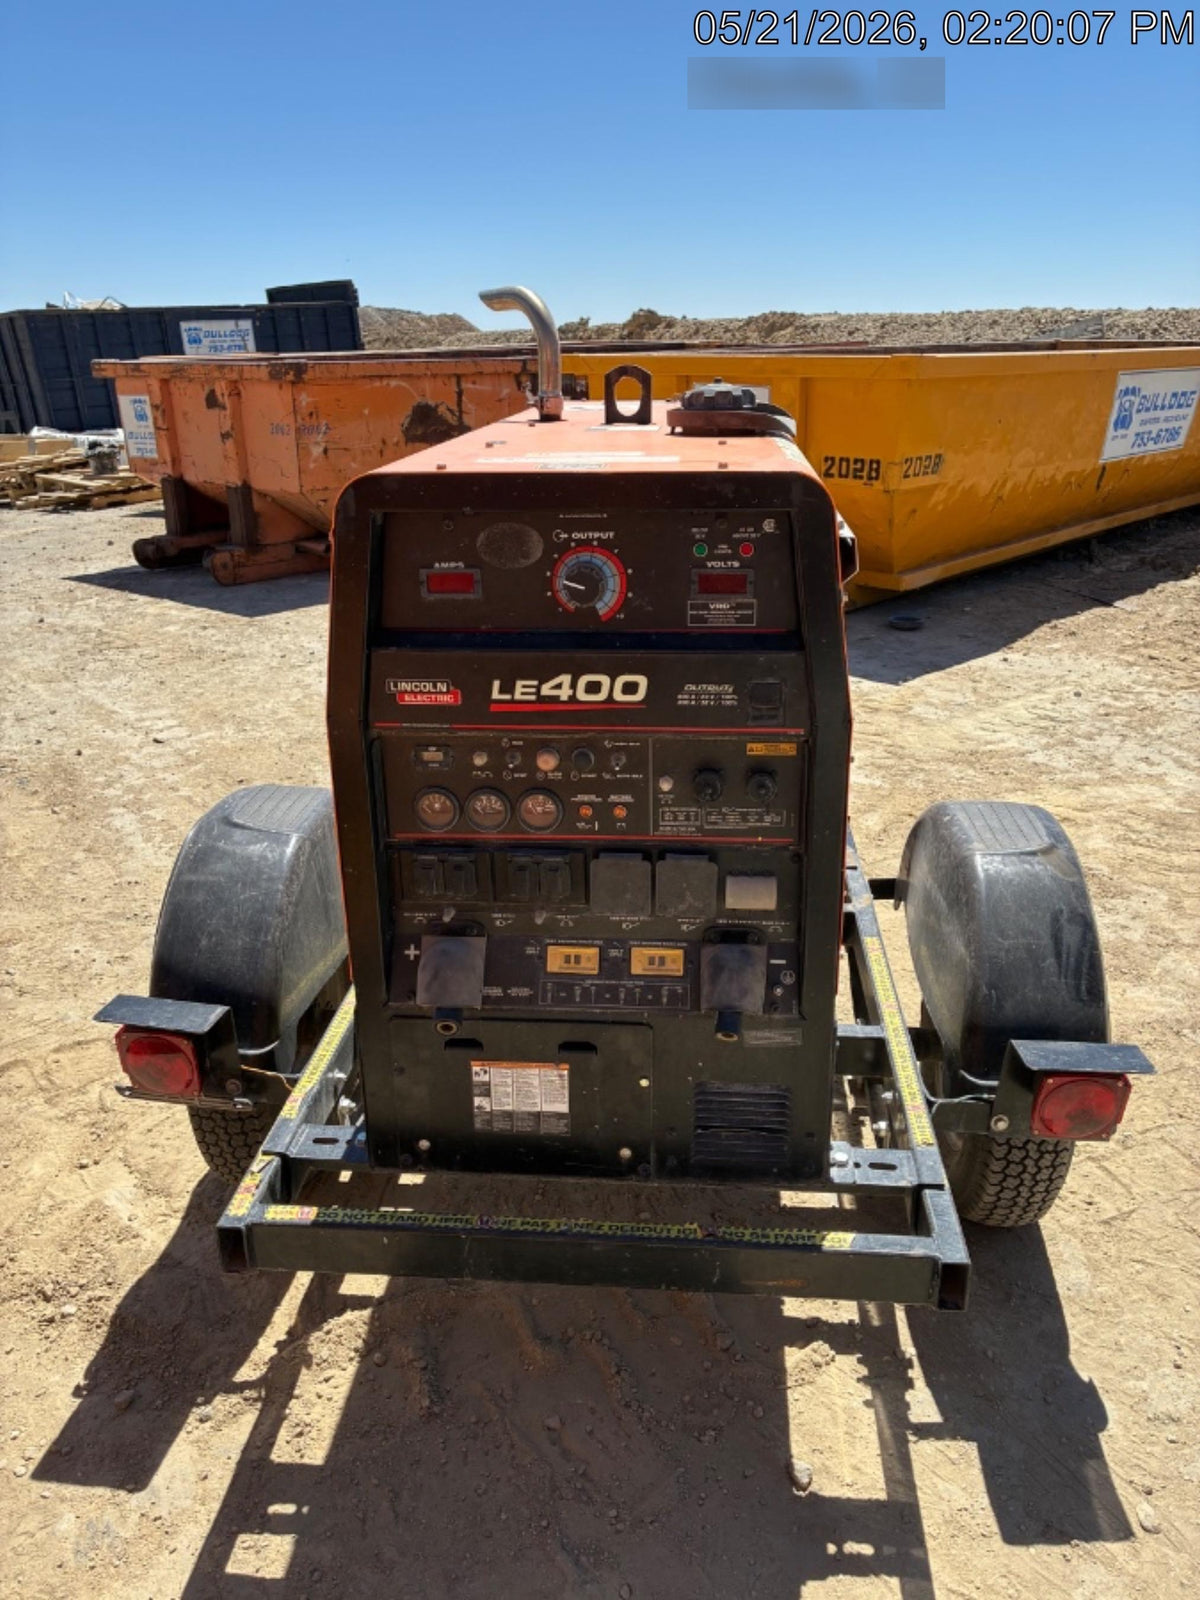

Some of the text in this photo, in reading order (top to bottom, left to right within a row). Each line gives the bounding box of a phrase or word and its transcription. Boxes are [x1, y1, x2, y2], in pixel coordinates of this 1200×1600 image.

[1136, 390, 1198, 414] BULLDOG
[823, 455, 881, 481] 2028
[903, 453, 944, 479] 2028
[571, 531, 615, 540] OUTPUT
[433, 561, 465, 569] AMPS
[705, 560, 740, 569] VOLTS
[390, 681, 448, 693] LINCOLN
[491, 673, 648, 702] LE400
[404, 693, 455, 702] ELECTRIC
[318, 1211, 338, 1220] DO
[342, 1212, 372, 1221] NOT
[376, 1213, 428, 1223] STAND
[432, 1215, 474, 1226] HERE
[520, 1219, 550, 1228] PAS
[608, 1223, 675, 1234] DEBOUT
[722, 1229, 745, 1239] NO
[774, 1232, 817, 1243] PARE
